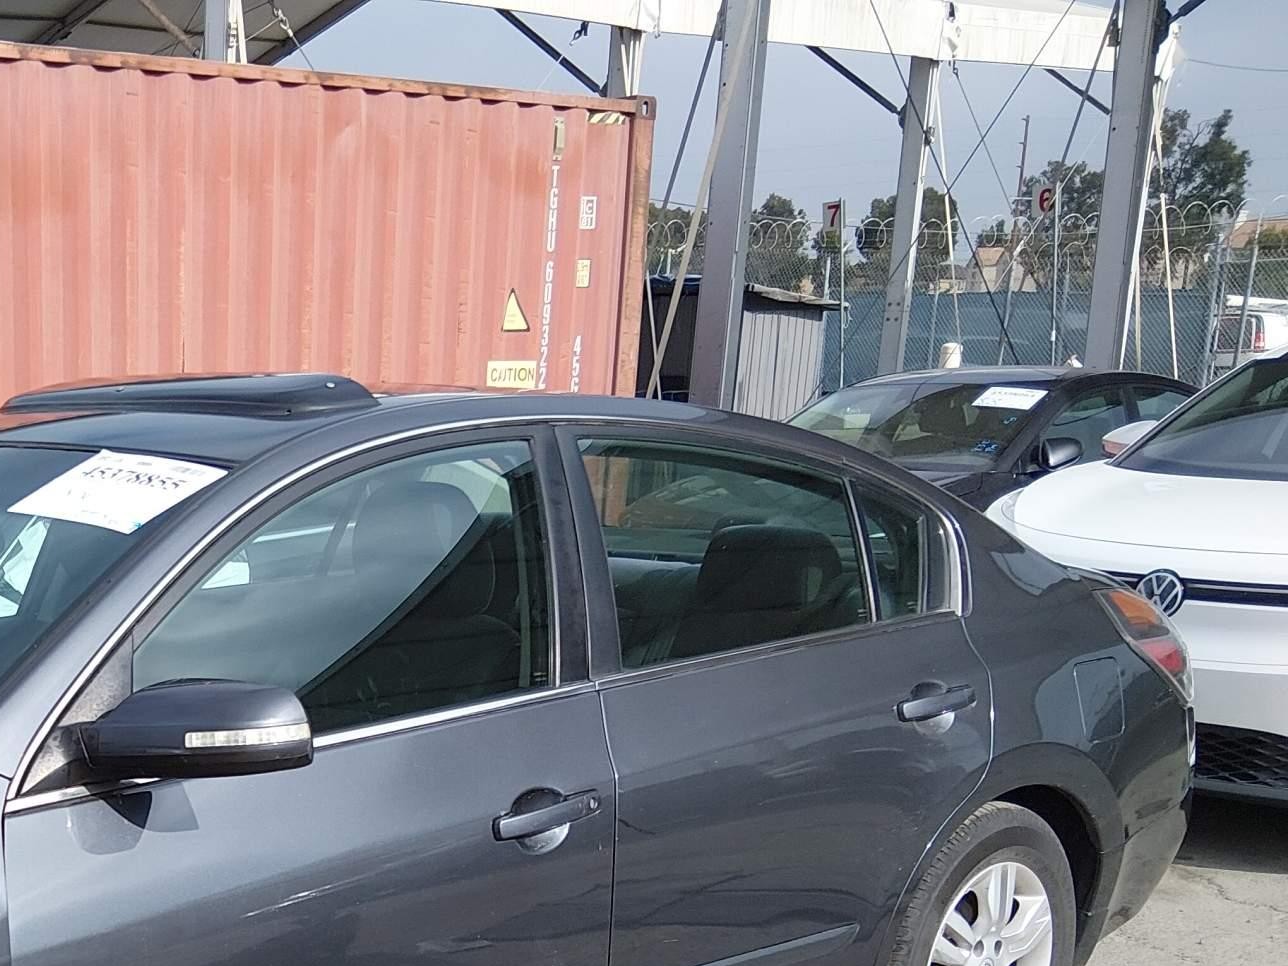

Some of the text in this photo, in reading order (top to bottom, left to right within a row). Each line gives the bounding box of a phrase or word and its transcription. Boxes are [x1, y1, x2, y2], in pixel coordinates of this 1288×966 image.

[546, 165, 561, 252] TGHU
[1039, 188, 1054, 212] 6
[826, 203, 841, 228] 7
[81, 466, 188, 490] 45378855
